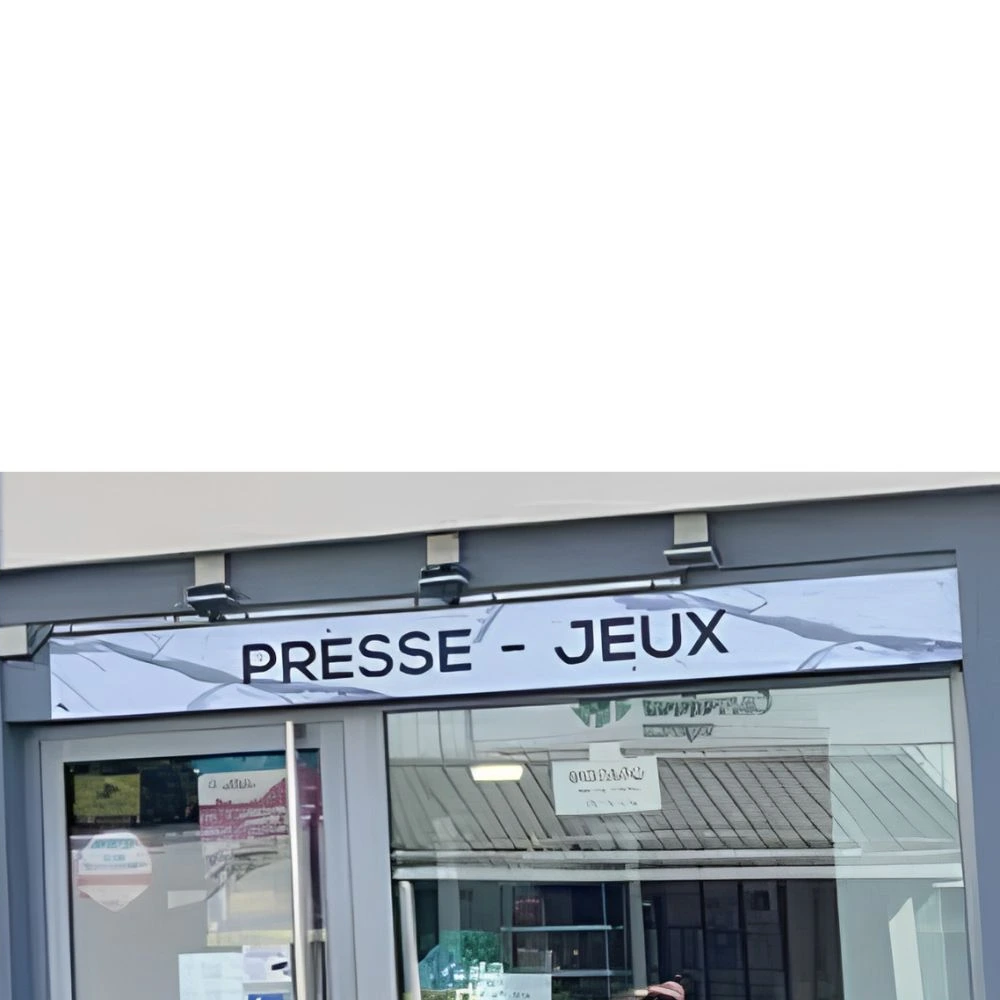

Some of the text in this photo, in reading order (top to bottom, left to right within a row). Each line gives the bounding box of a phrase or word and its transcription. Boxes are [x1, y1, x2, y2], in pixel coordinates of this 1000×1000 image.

[242, 608, 729, 685] PRESSE - JEUX
